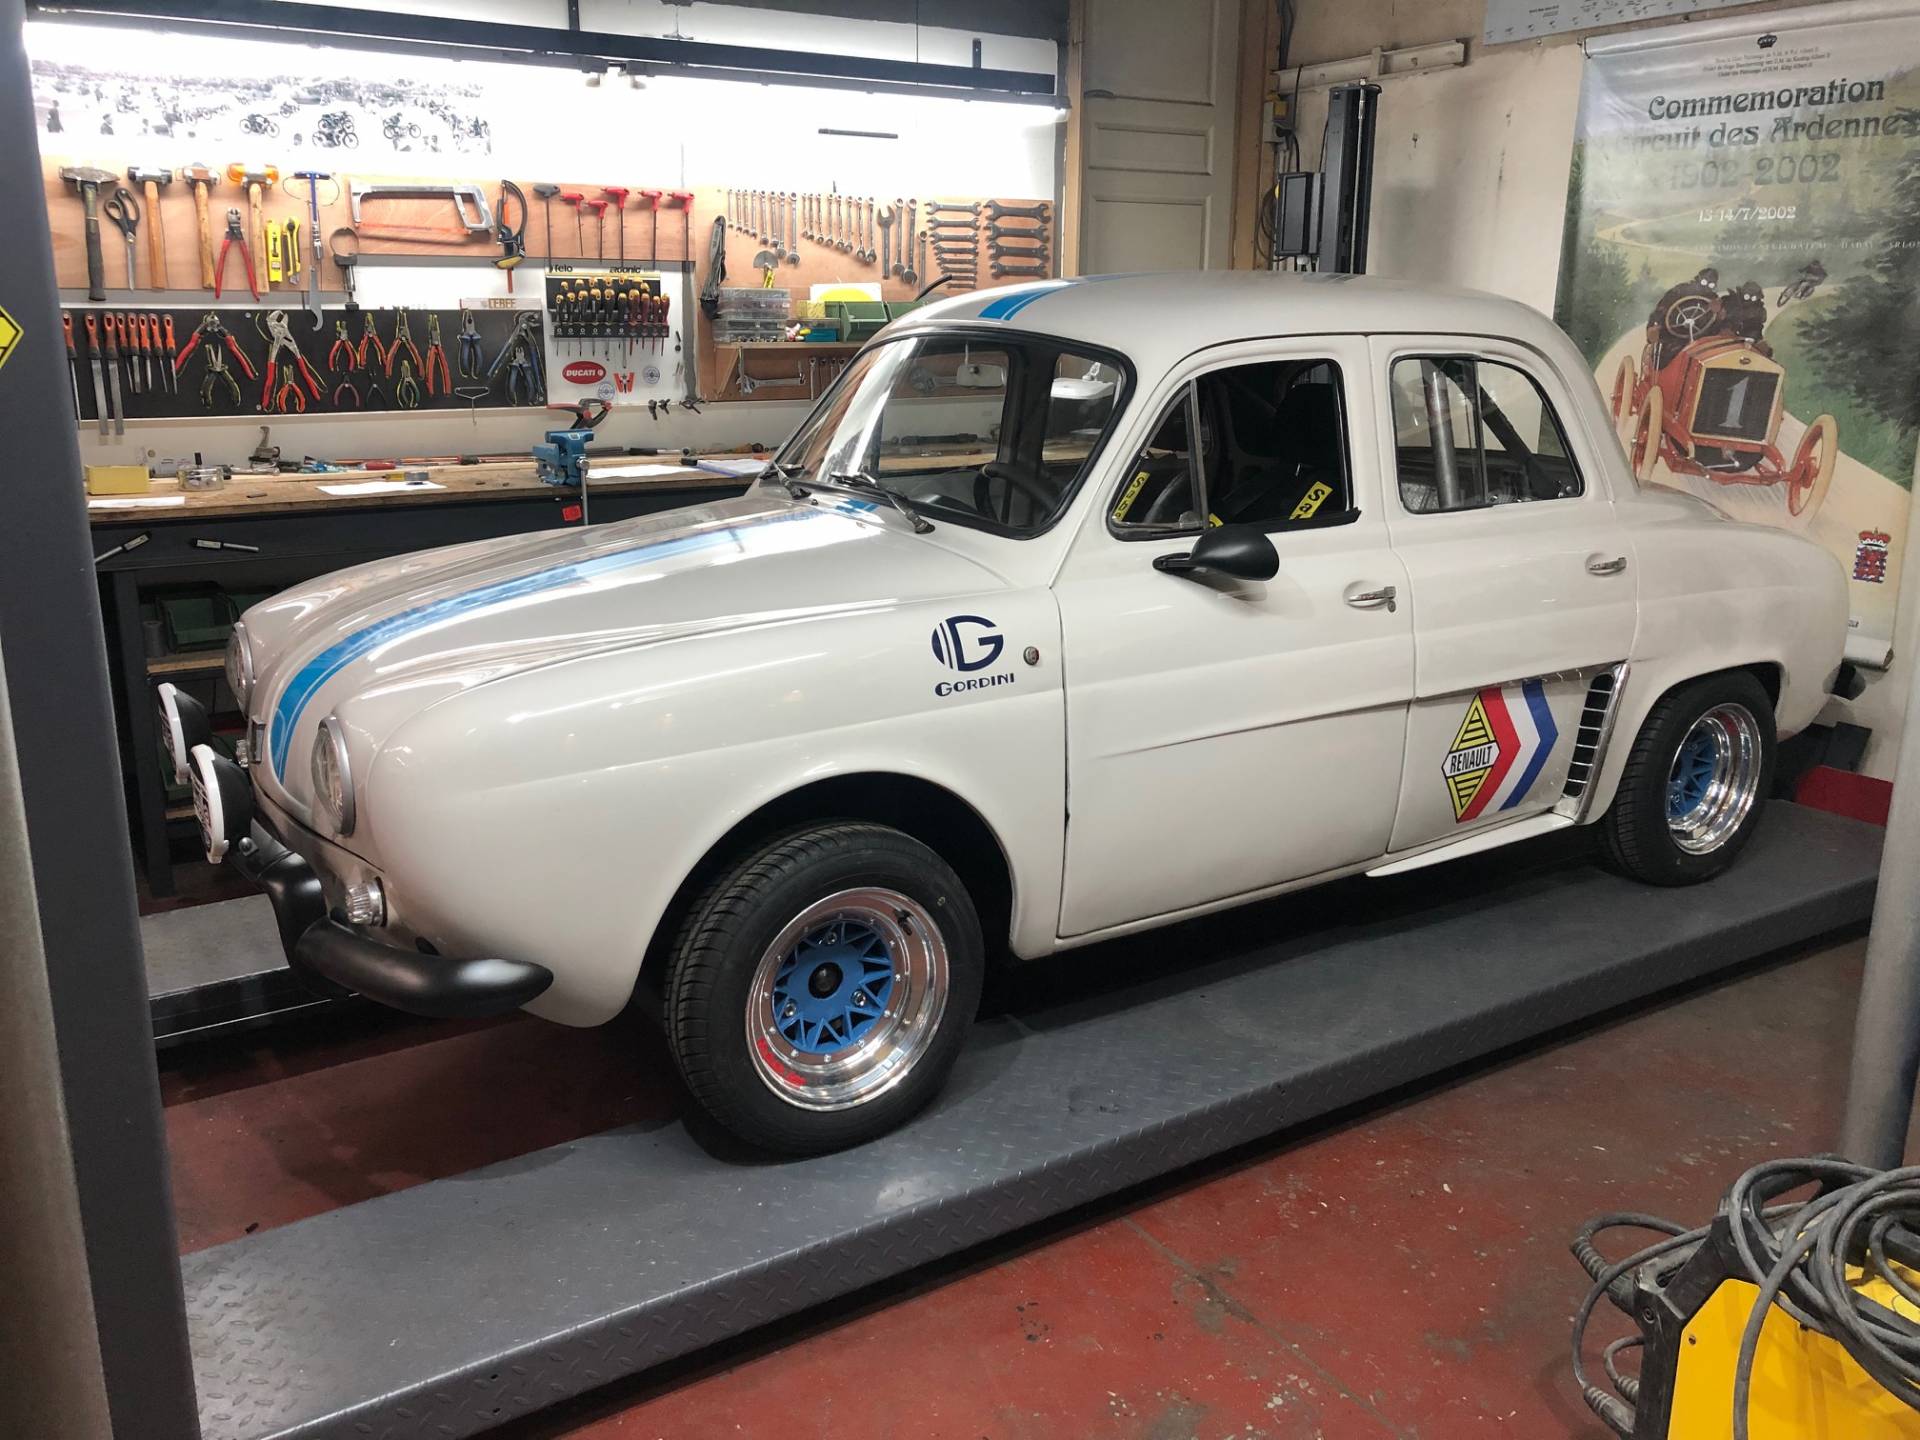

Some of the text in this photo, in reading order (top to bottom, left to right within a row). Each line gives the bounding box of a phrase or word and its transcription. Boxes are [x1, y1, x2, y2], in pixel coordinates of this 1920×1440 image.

[1648, 78, 1885, 121] Commemoration
[1708, 122, 1760, 148] des
[1670, 152, 1841, 191] 1902-2002
[566, 369, 596, 377] DUCATI
[1718, 376, 1750, 429] 1
[934, 672, 1015, 697] GORDINI
[1450, 745, 1493, 774] RENAULT
